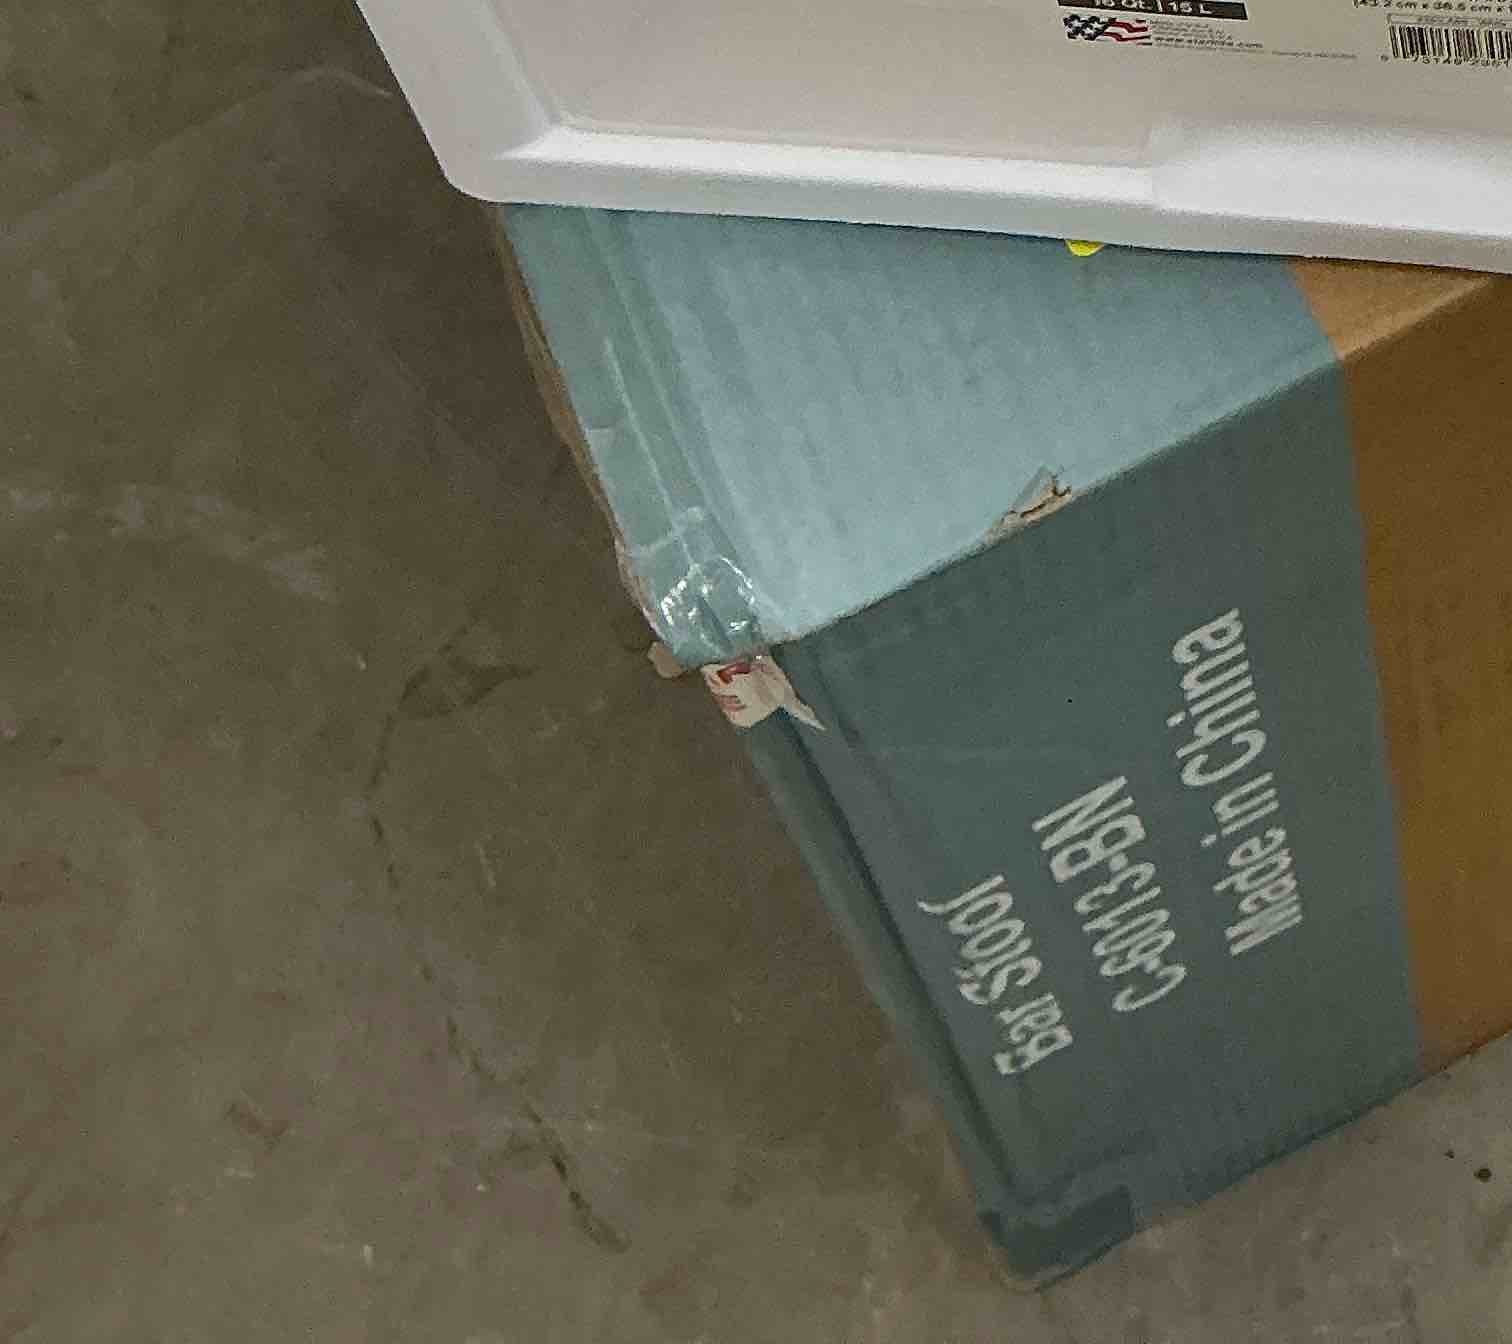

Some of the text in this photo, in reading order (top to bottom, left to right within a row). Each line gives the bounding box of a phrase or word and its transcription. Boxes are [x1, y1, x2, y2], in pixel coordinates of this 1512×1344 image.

[1032, 775, 1188, 1013] C-6013-BN
[1167, 608, 1303, 957] Made in China
[917, 874, 1073, 1076] Bar Stool
